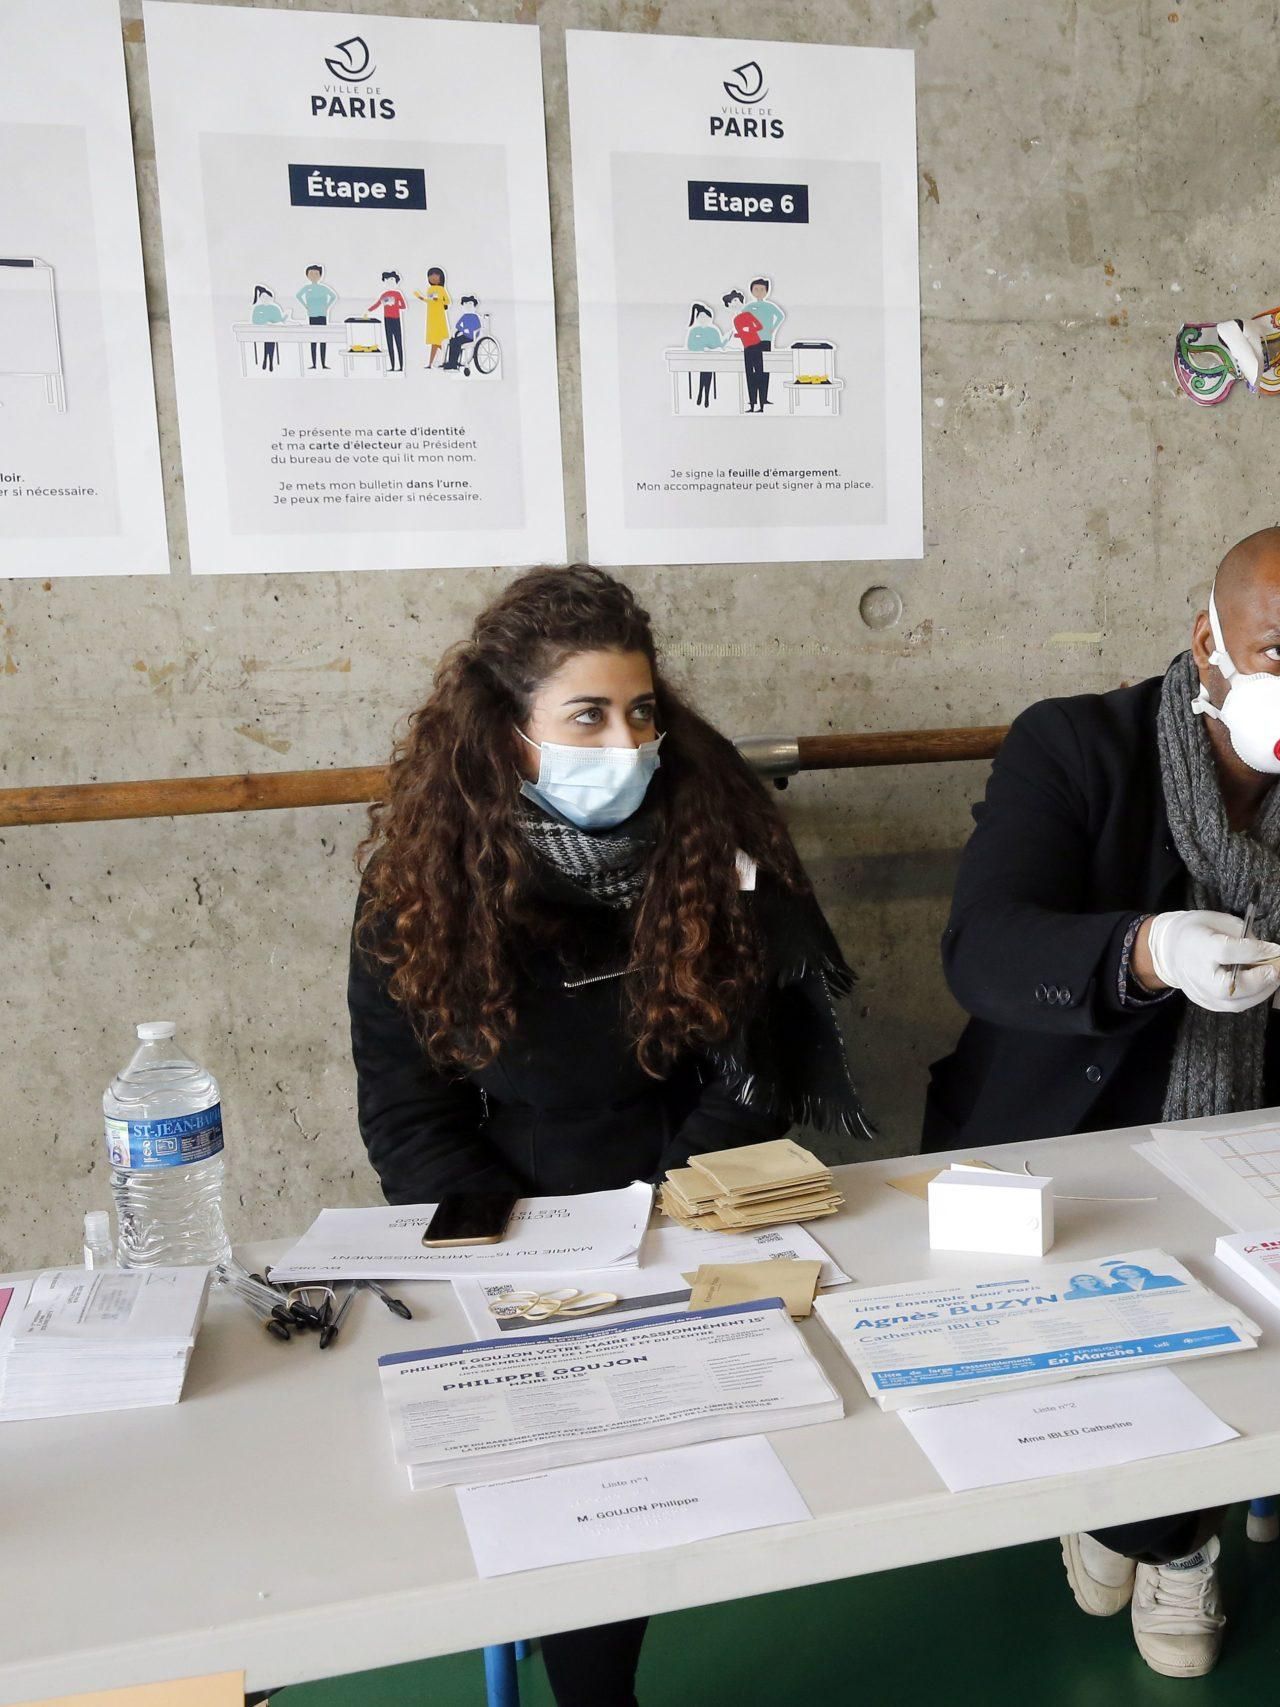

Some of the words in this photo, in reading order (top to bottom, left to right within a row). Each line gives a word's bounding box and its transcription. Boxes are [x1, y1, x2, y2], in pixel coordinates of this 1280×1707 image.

[324, 85, 359, 94] VILLE
[366, 87, 382, 95] DE
[311, 95, 396, 119] PARIS
[722, 107, 753, 115] VILLE
[759, 108, 772, 116] DE
[710, 116, 785, 139] PARIS
[307, 170, 387, 203] Étape
[394, 179, 410, 200] 5
[704, 186, 774, 217] Étape
[780, 194, 795, 214] 6
[282, 428, 295, 437] Je
[299, 428, 351, 439] présente
[377, 428, 406, 437] carte
[410, 427, 465, 436] d'identité
[271, 442, 284, 451] et
[287, 443, 305, 451] ma
[309, 441, 340, 450] carte
[343, 441, 401, 450] d'électeur
[423, 440, 478, 449] Président
[271, 455, 286, 464] du
[290, 454, 331, 464] bureau
[335, 454, 350, 463] de
[353, 454, 379, 463] vote
[382, 454, 400, 465] qui
[403, 453, 415, 462] lit
[418, 454, 444, 462] mon
[447, 454, 477, 462] nom.
[670, 469, 684, 479] Je
[686, 469, 714, 480] signe
[716, 469, 725, 478] la
[728, 468, 760, 478] feuille
[13, 486, 22, 497] si
[26, 485, 98, 497] nécessaire.
[279, 481, 293, 491] Je
[296, 481, 326, 490] mets
[329, 481, 356, 490] mon
[359, 479, 403, 489] bulletin
[406, 479, 434, 489] dans
[636, 482, 660, 491] Mon
[663, 482, 752, 492] accompagnateur
[755, 481, 779, 491] peut
[782, 481, 813, 491] signer
[816, 481, 822, 490] à
[844, 480, 874, 491] place.
[273, 495, 287, 504] Je
[290, 496, 320, 506] peux
[323, 495, 342, 503] me
[345, 493, 371, 503] faire
[374, 493, 404, 502] aider
[406, 493, 416, 502] si
[419, 492, 482, 502] nécessaire.
[546, 1246, 593, 1255] MAIRIE
[855, 1301, 890, 1313] Liste
[896, 1294, 964, 1308] Ensemble
[970, 1290, 1001, 1300] pour
[1007, 1285, 1041, 1294] Paris
[936, 1299, 968, 1308] avec
[854, 1310, 940, 1330] Agnès
[950, 1294, 1058, 1316] BUZYN
[859, 1326, 943, 1343] Catherine
[949, 1318, 1000, 1331] IBLED
[400, 1359, 466, 1375] PHILIPPE
[470, 1352, 532, 1363] GOUJON
[536, 1345, 578, 1355] VOTRE
[584, 1337, 628, 1350] MAIRE
[631, 1319, 744, 1341] PASSIONNÉMENT
[461, 1354, 558, 1370] RASSEMBLEMENT
[595, 1342, 636, 1353] DROITE
[672, 1330, 713, 1341] CENTRE
[1048, 1357, 1069, 1367] En
[1073, 1348, 1131, 1362] Marche
[443, 1370, 546, 1391] PHILIPPE
[553, 1355, 648, 1376] GOUJON
[509, 1377, 547, 1387] MAIRE
[552, 1373, 568, 1381] DU
[1033, 1405, 1057, 1414] Liste
[1058, 1401, 1078, 1410] n°2
[1017, 1433, 1045, 1445] Mme
[1048, 1428, 1079, 1440] IBLED
[1082, 1420, 1133, 1435] Catherine
[602, 1480, 628, 1489] Liste
[630, 1476, 650, 1486] n°1
[576, 1513, 593, 1523] M.
[596, 1504, 648, 1519] GOUJON
[651, 1496, 699, 1510] Philippe
